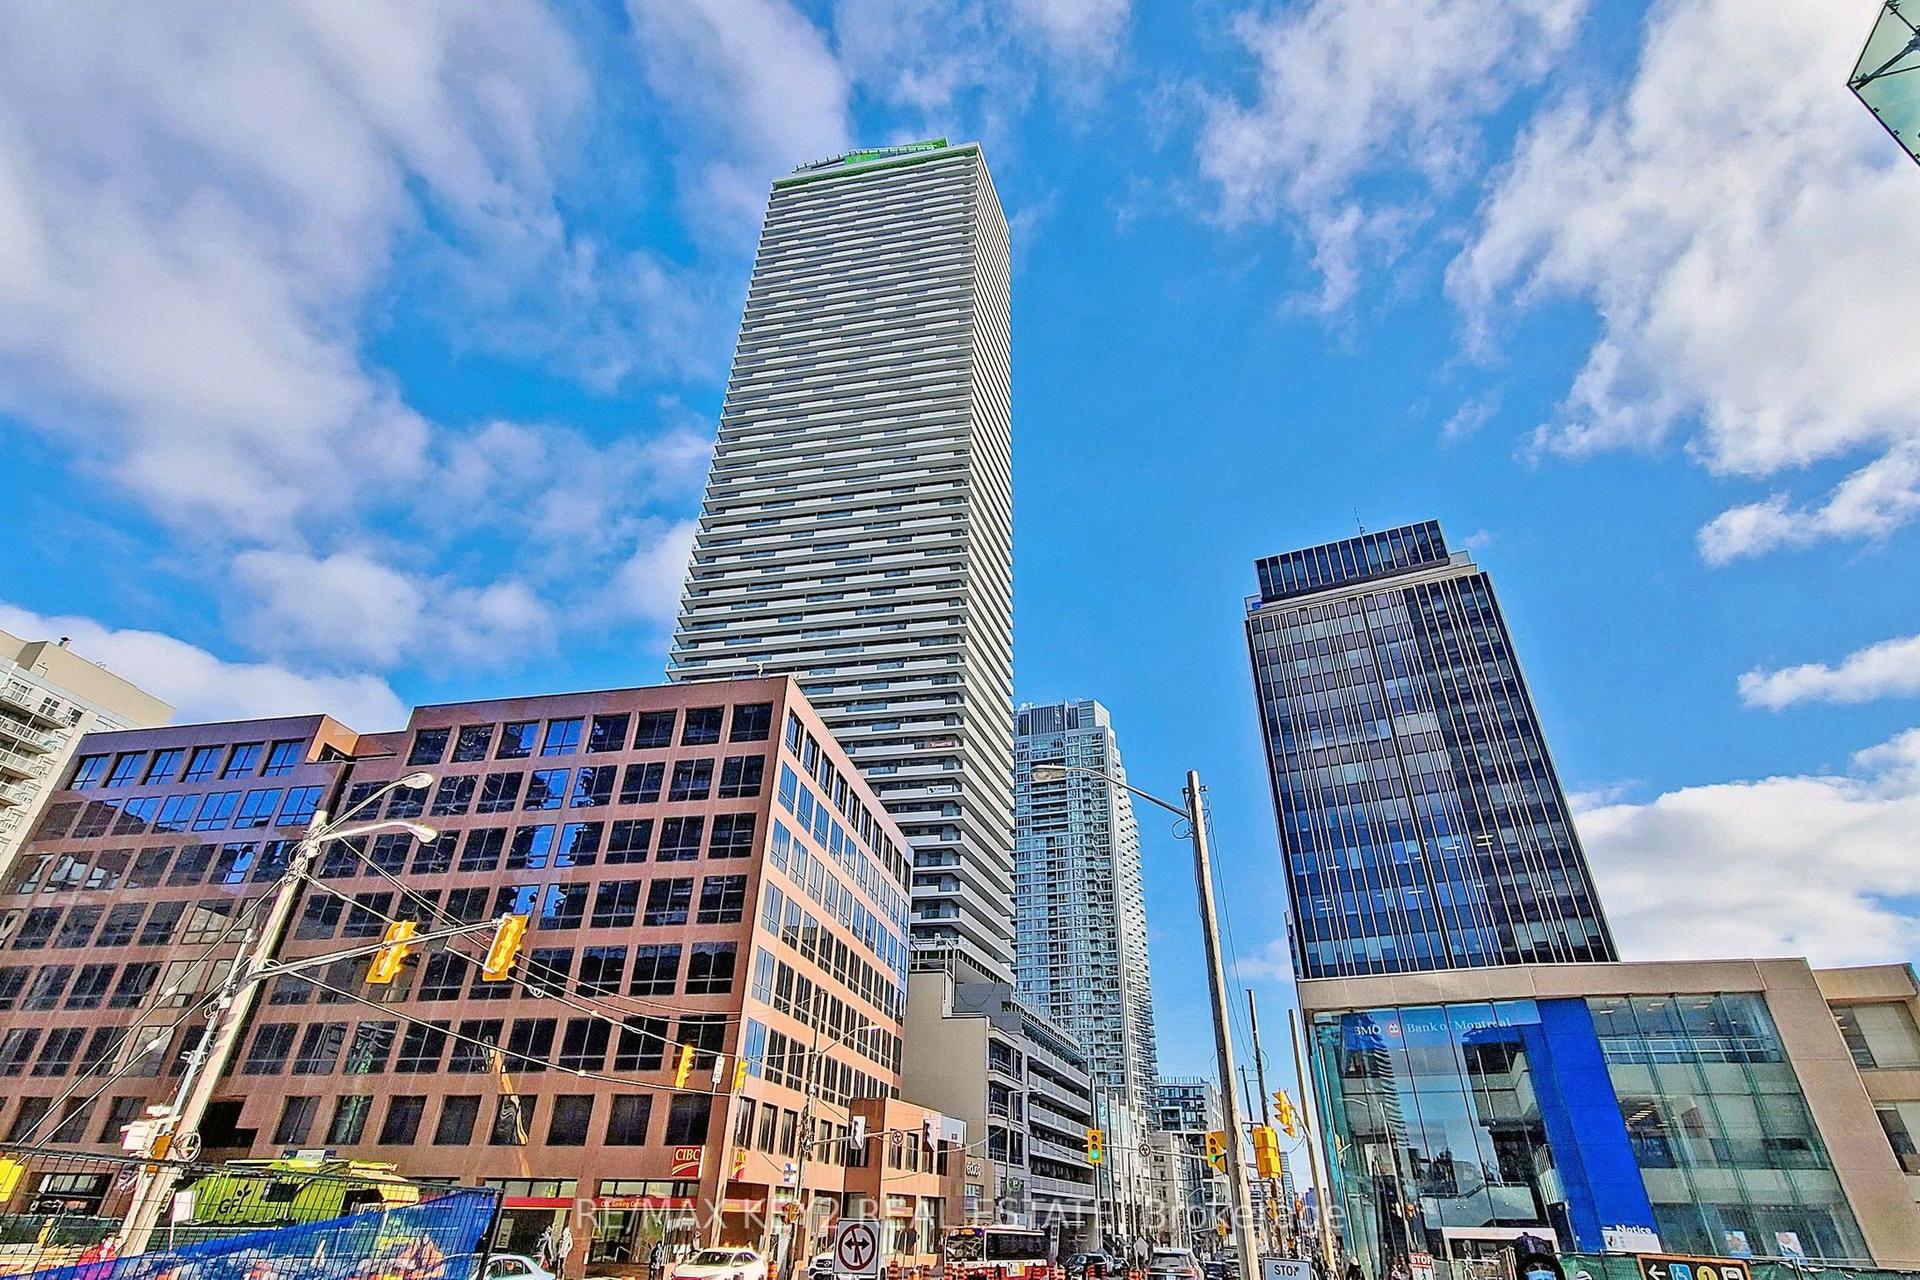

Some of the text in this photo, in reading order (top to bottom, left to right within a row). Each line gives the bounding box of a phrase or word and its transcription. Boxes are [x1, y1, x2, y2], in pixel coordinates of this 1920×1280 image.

[1353, 1024, 1381, 1036] BMO
[1407, 1021, 1438, 1034] Bank
[1454, 1017, 1512, 1031] Montreal
[675, 1148, 701, 1161] CIBC
[219, 1198, 244, 1214] GFL
[1615, 1224, 1652, 1235] Notice
[1411, 1254, 1434, 1266] STOP
